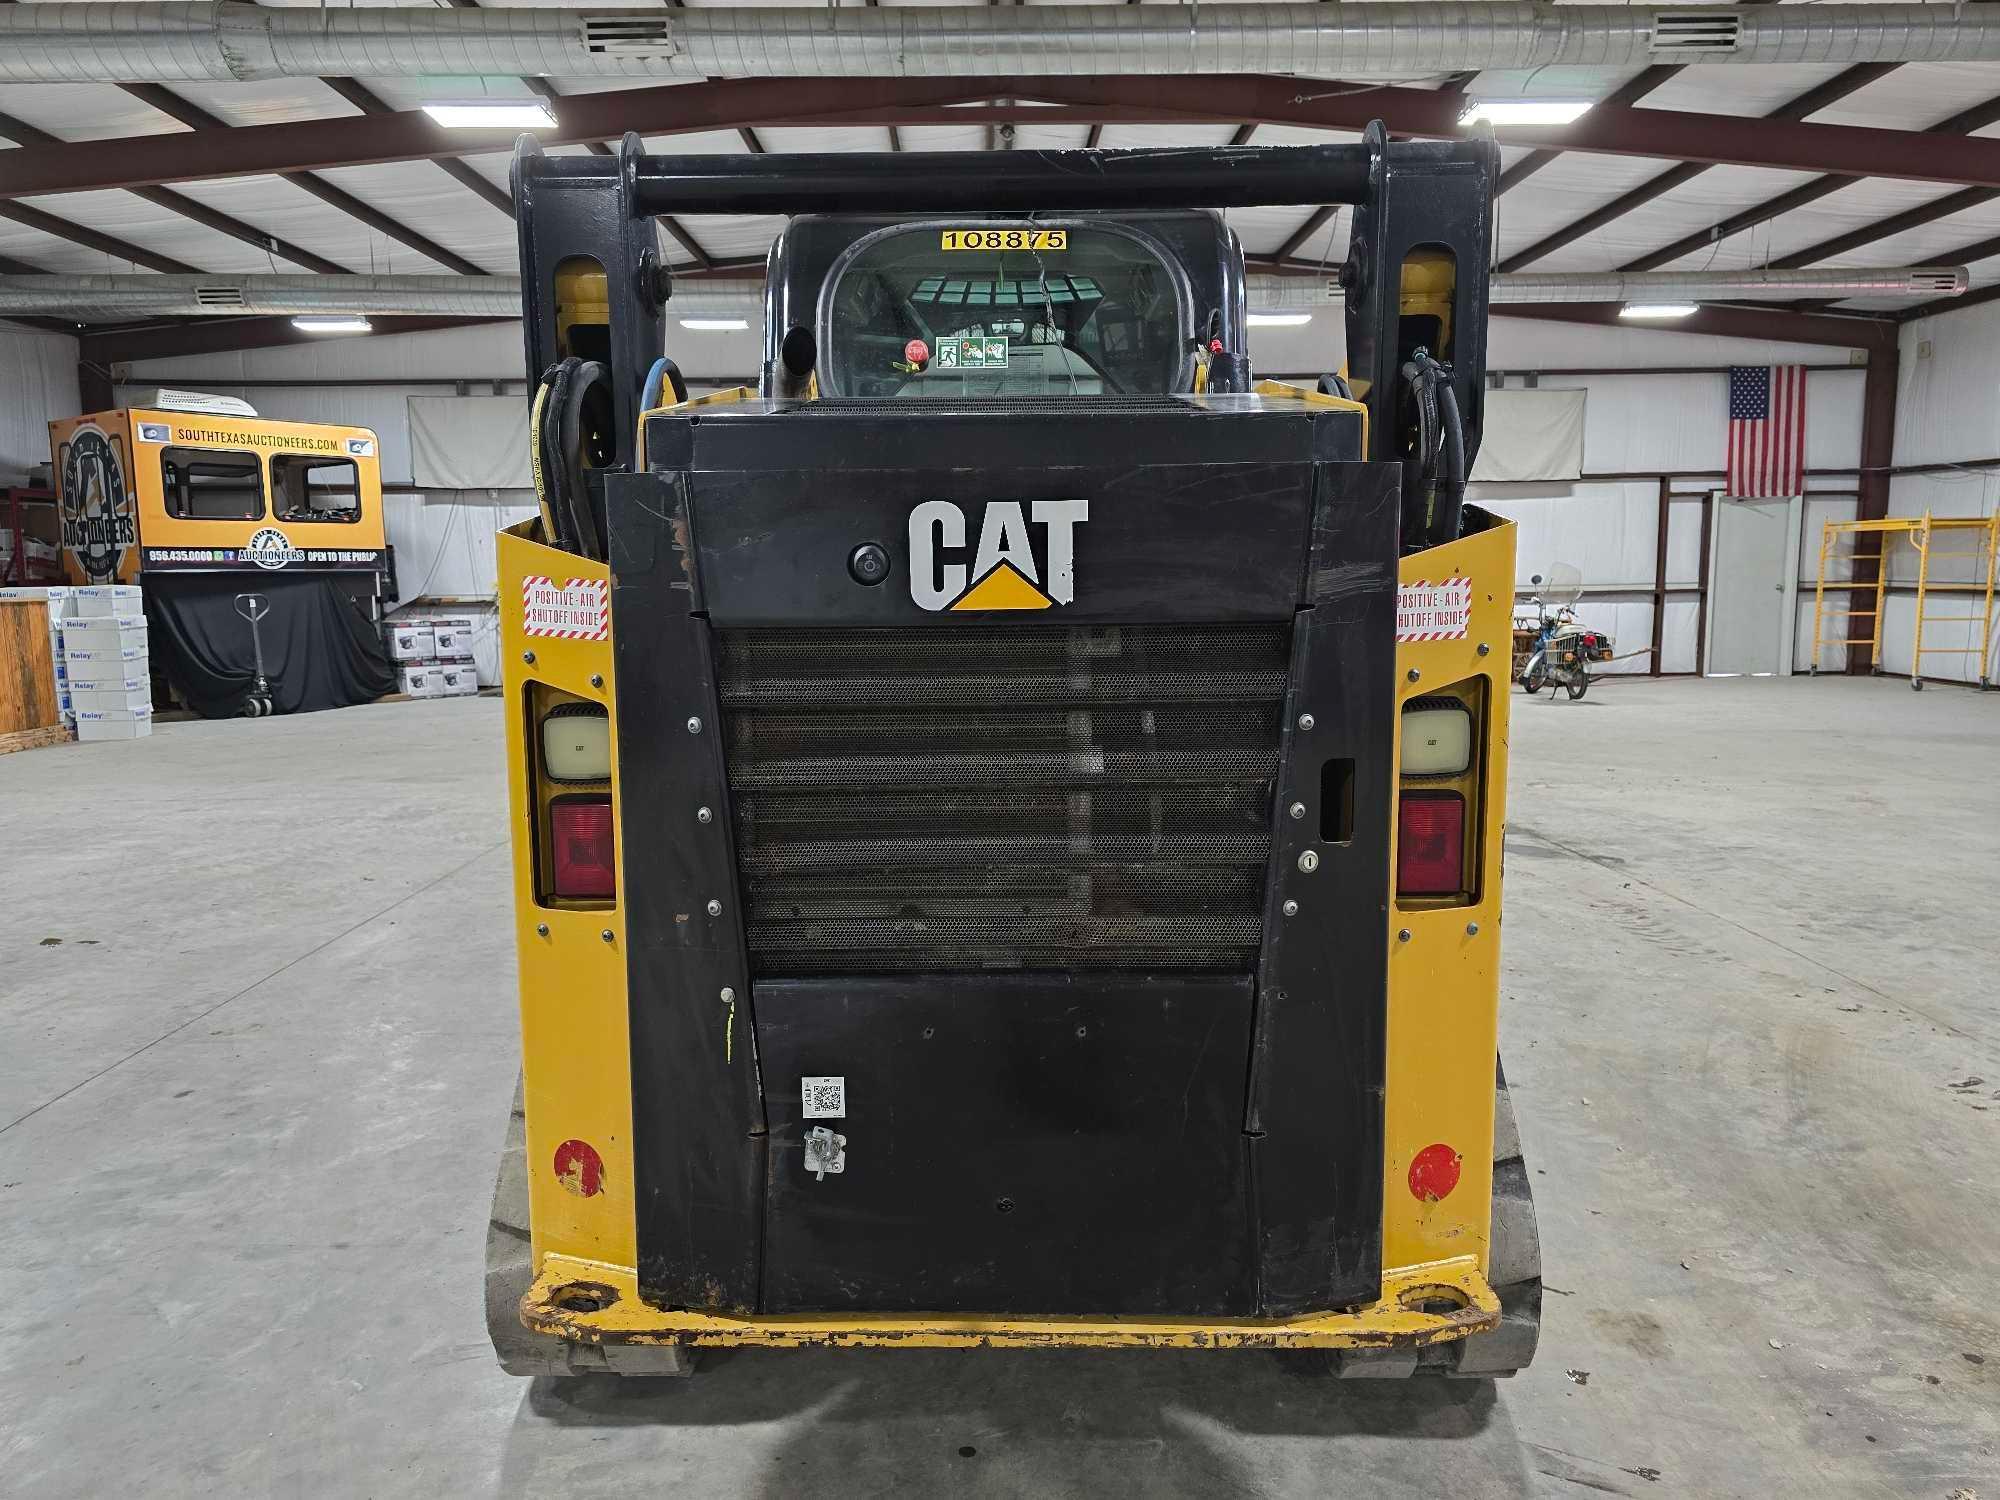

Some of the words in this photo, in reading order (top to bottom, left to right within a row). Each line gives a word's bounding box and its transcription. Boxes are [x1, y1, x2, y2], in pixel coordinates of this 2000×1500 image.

[945, 231, 1064, 249] 108875
[178, 428, 339, 451] SOUTHTEXASAUCTIONEERS.COM
[239, 549, 305, 561] AUCTIONEERS
[307, 551, 327, 562] OPEN
[327, 551, 338, 562] TO
[338, 551, 352, 562] THE
[908, 499, 1089, 611] CAT
[79, 589, 99, 597] Relay
[535, 590, 574, 606] POSITIVE
[580, 592, 594, 607] AIR
[1397, 592, 1438, 609] POSITIVE
[1445, 591, 1460, 607] AIR
[532, 608, 568, 624] SHUTOFF
[570, 611, 599, 626] INSIDE
[1398, 612, 1432, 628] HUTOFF
[1434, 610, 1463, 626] INSIDE
[66, 621, 87, 629] Relay
[70, 652, 91, 660] Relay
[74, 682, 95, 690] Relay
[81, 712, 103, 720] Relay
